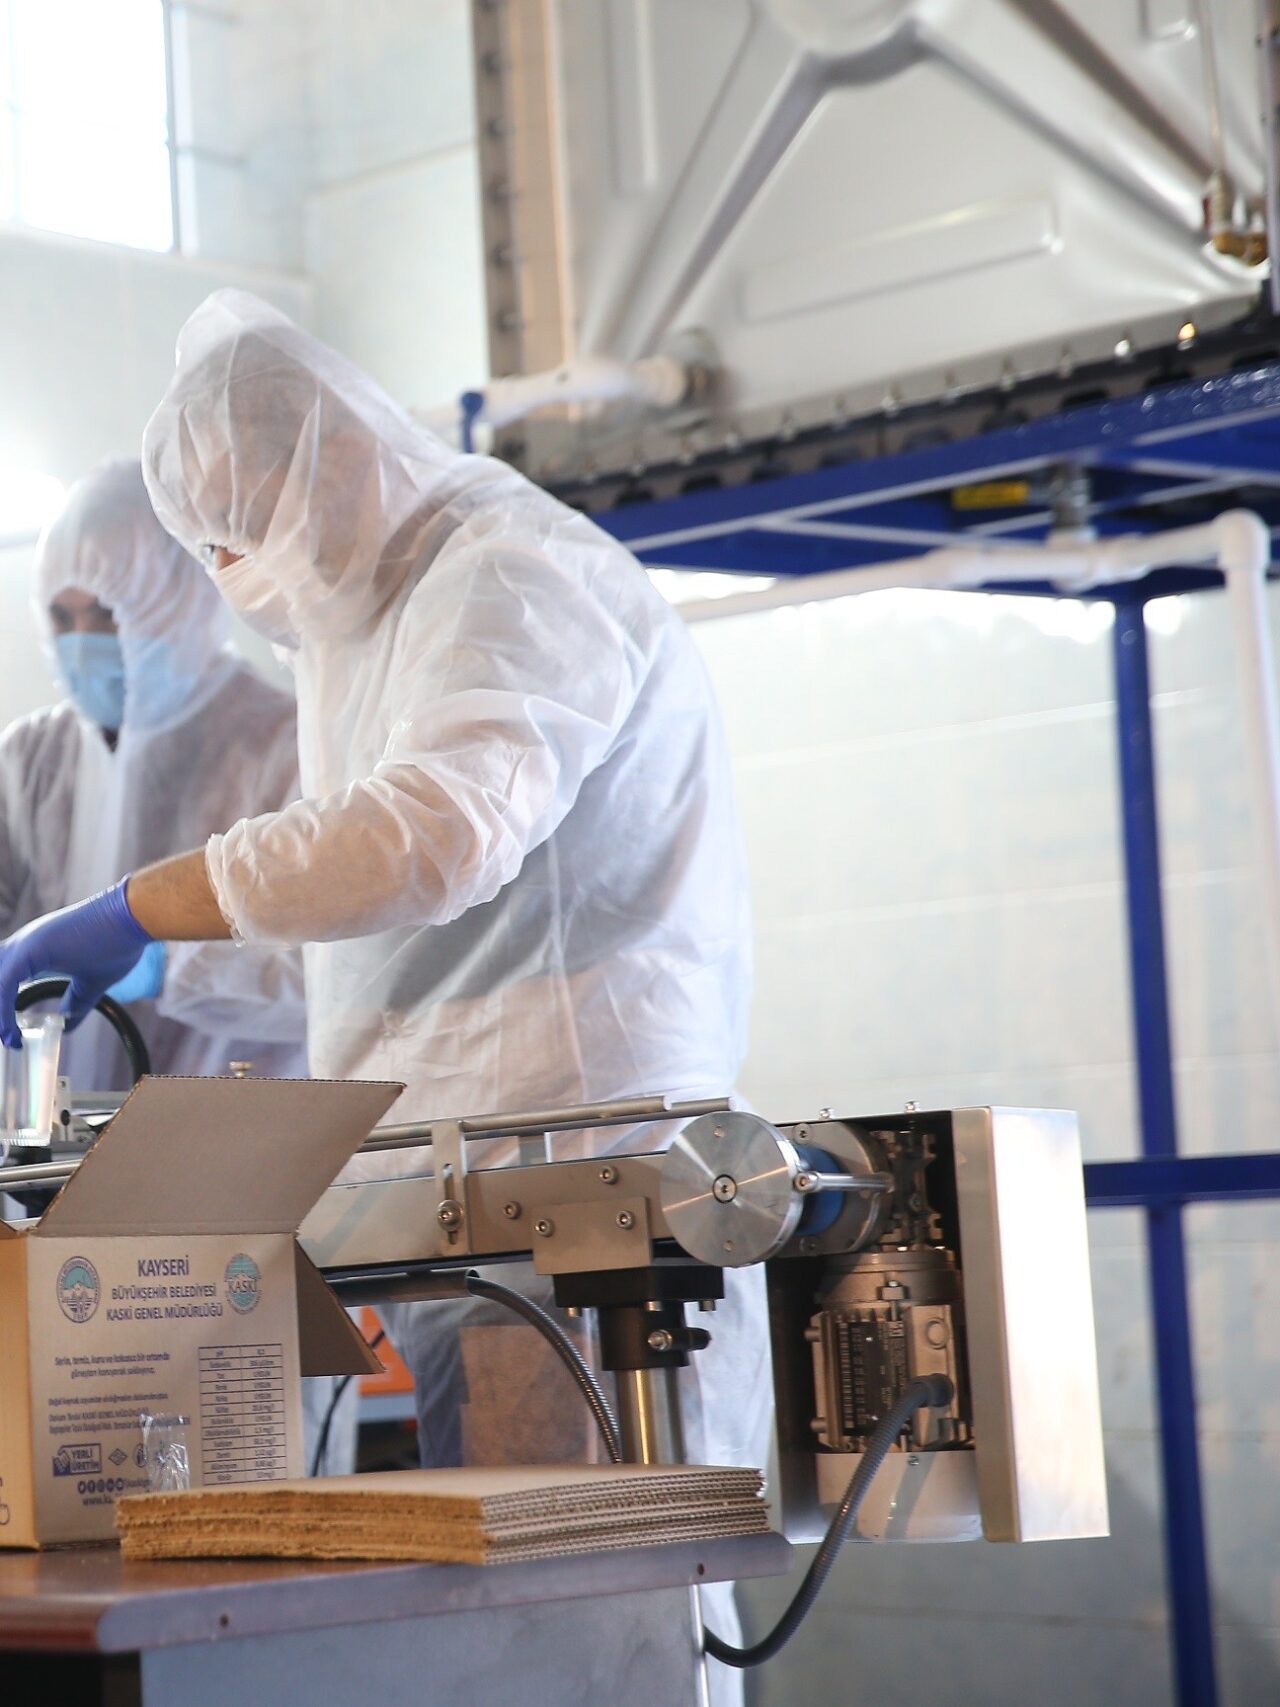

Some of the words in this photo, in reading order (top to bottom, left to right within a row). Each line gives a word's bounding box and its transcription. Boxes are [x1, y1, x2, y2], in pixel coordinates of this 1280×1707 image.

[138, 1255, 189, 1277] KAYSERİ
[112, 1284, 168, 1302] BÜYÜKŞEHİR
[170, 1282, 216, 1298] BELEDİYESİ
[134, 1305, 163, 1320] GENEL
[164, 1302, 223, 1319] MÜDÜRLÜĞÜ
